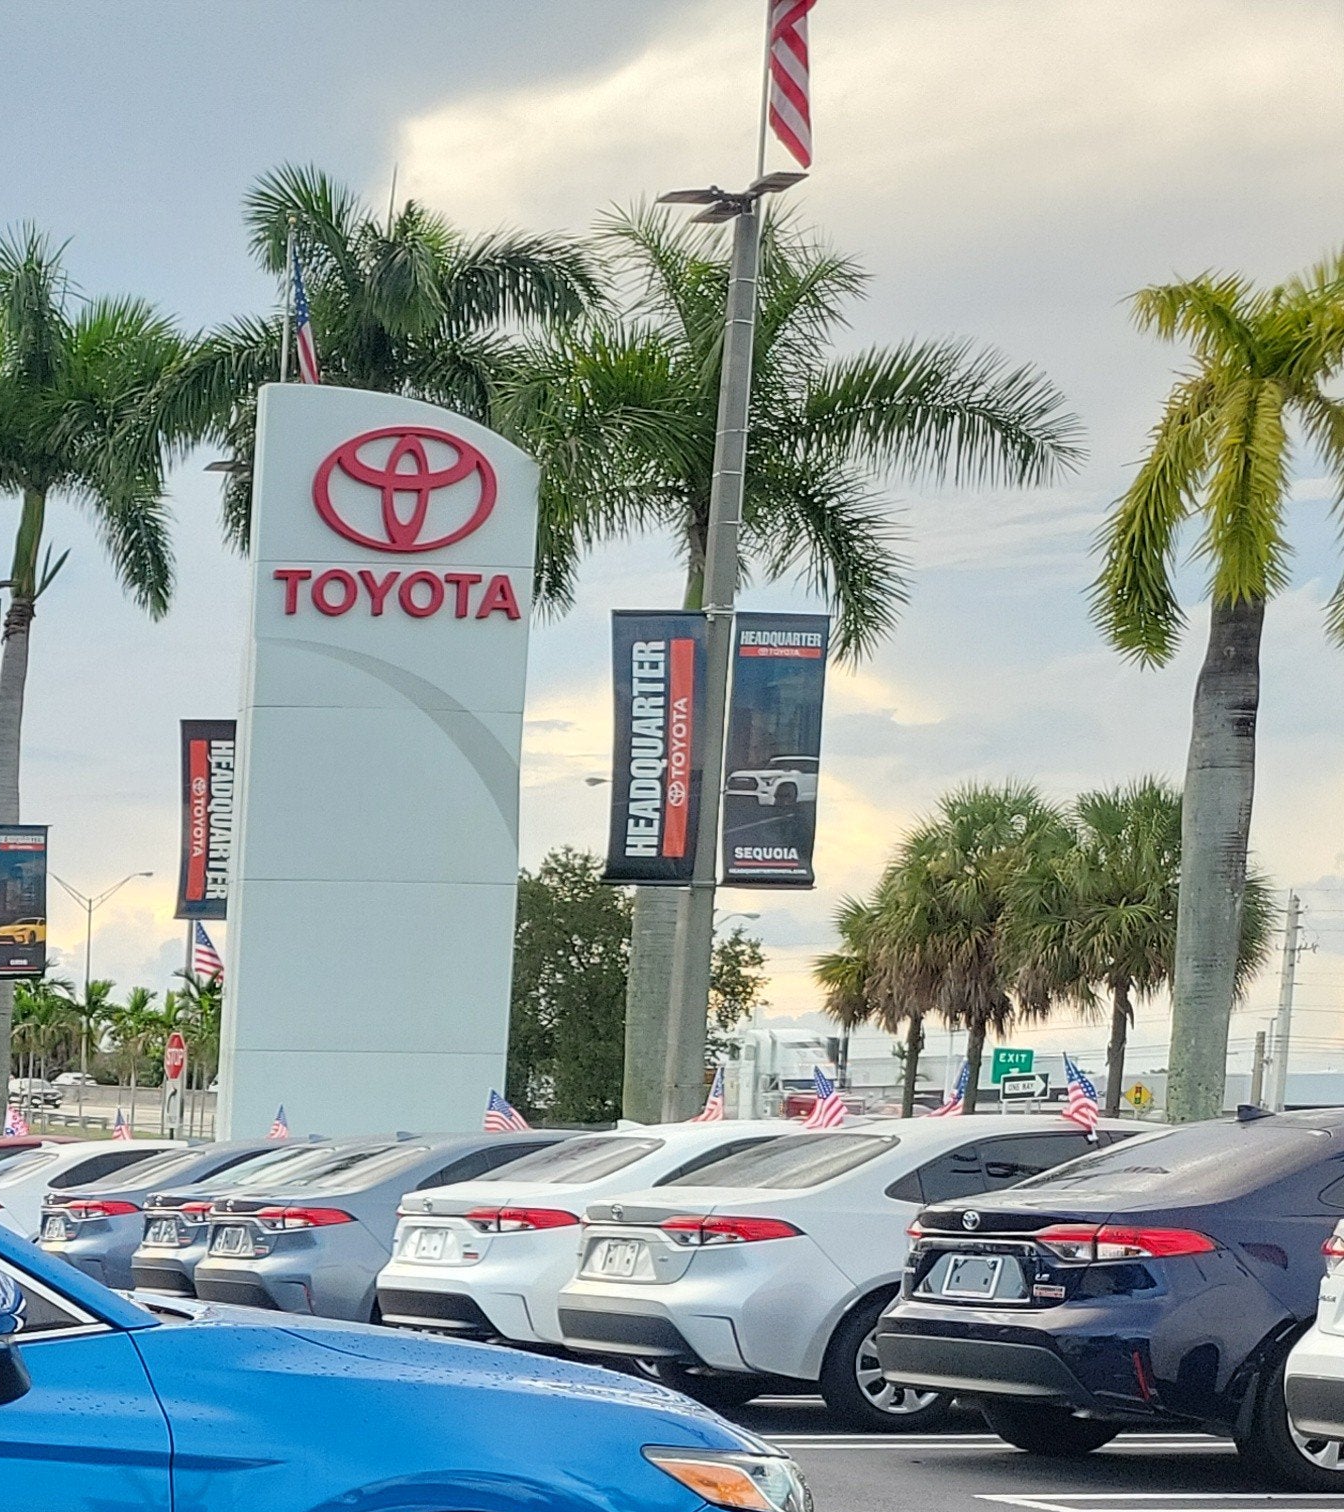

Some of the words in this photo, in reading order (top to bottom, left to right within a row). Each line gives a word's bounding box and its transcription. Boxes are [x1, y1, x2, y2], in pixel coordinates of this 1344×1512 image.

[273, 568, 521, 621] TOYOTA
[740, 630, 822, 648] HEADQUARTER
[625, 640, 669, 858] HEADQUARTER
[671, 697, 689, 778] TOYOTA
[193, 798, 205, 857] TOYOTA
[205, 740, 235, 900] HEADQUARTER
[734, 846, 799, 861] SEQUOIA
[167, 1048, 184, 1067] STOP
[999, 1052, 1028, 1064] EXIT
[1008, 1082, 1020, 1091] ONE
